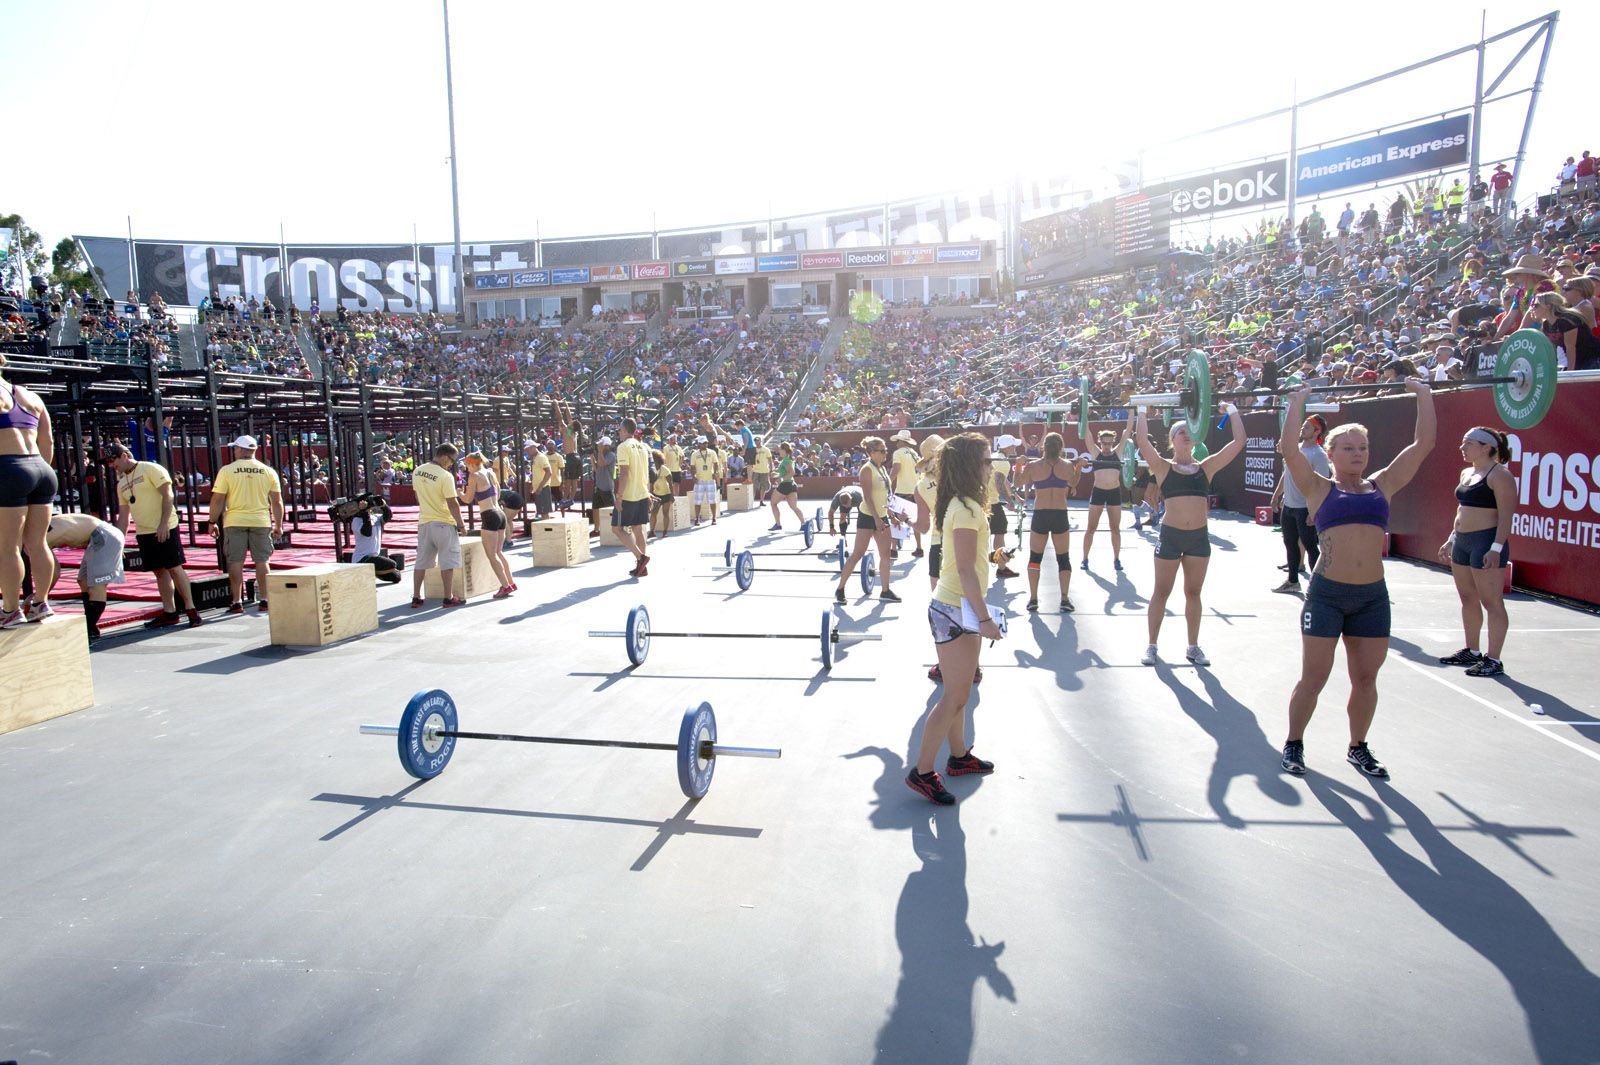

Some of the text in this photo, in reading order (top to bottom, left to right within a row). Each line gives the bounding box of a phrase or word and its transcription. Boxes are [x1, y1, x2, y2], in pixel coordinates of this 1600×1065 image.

[1299, 133, 1465, 181] American Express
[848, 253, 886, 264] Reebok
[1502, 339, 1537, 365] ROGUE
[1246, 437, 1275, 448] 2011 Reebok
[1245, 457, 1274, 470] CROSSFIT
[233, 467, 265, 475] JUDGE
[415, 470, 439, 482] JUDGE
[1245, 470, 1274, 488] GAMES
[1259, 510, 1267, 522] 3
[1510, 513, 1600, 549] RGING ELITE
[320, 579, 334, 637] ROGUE
